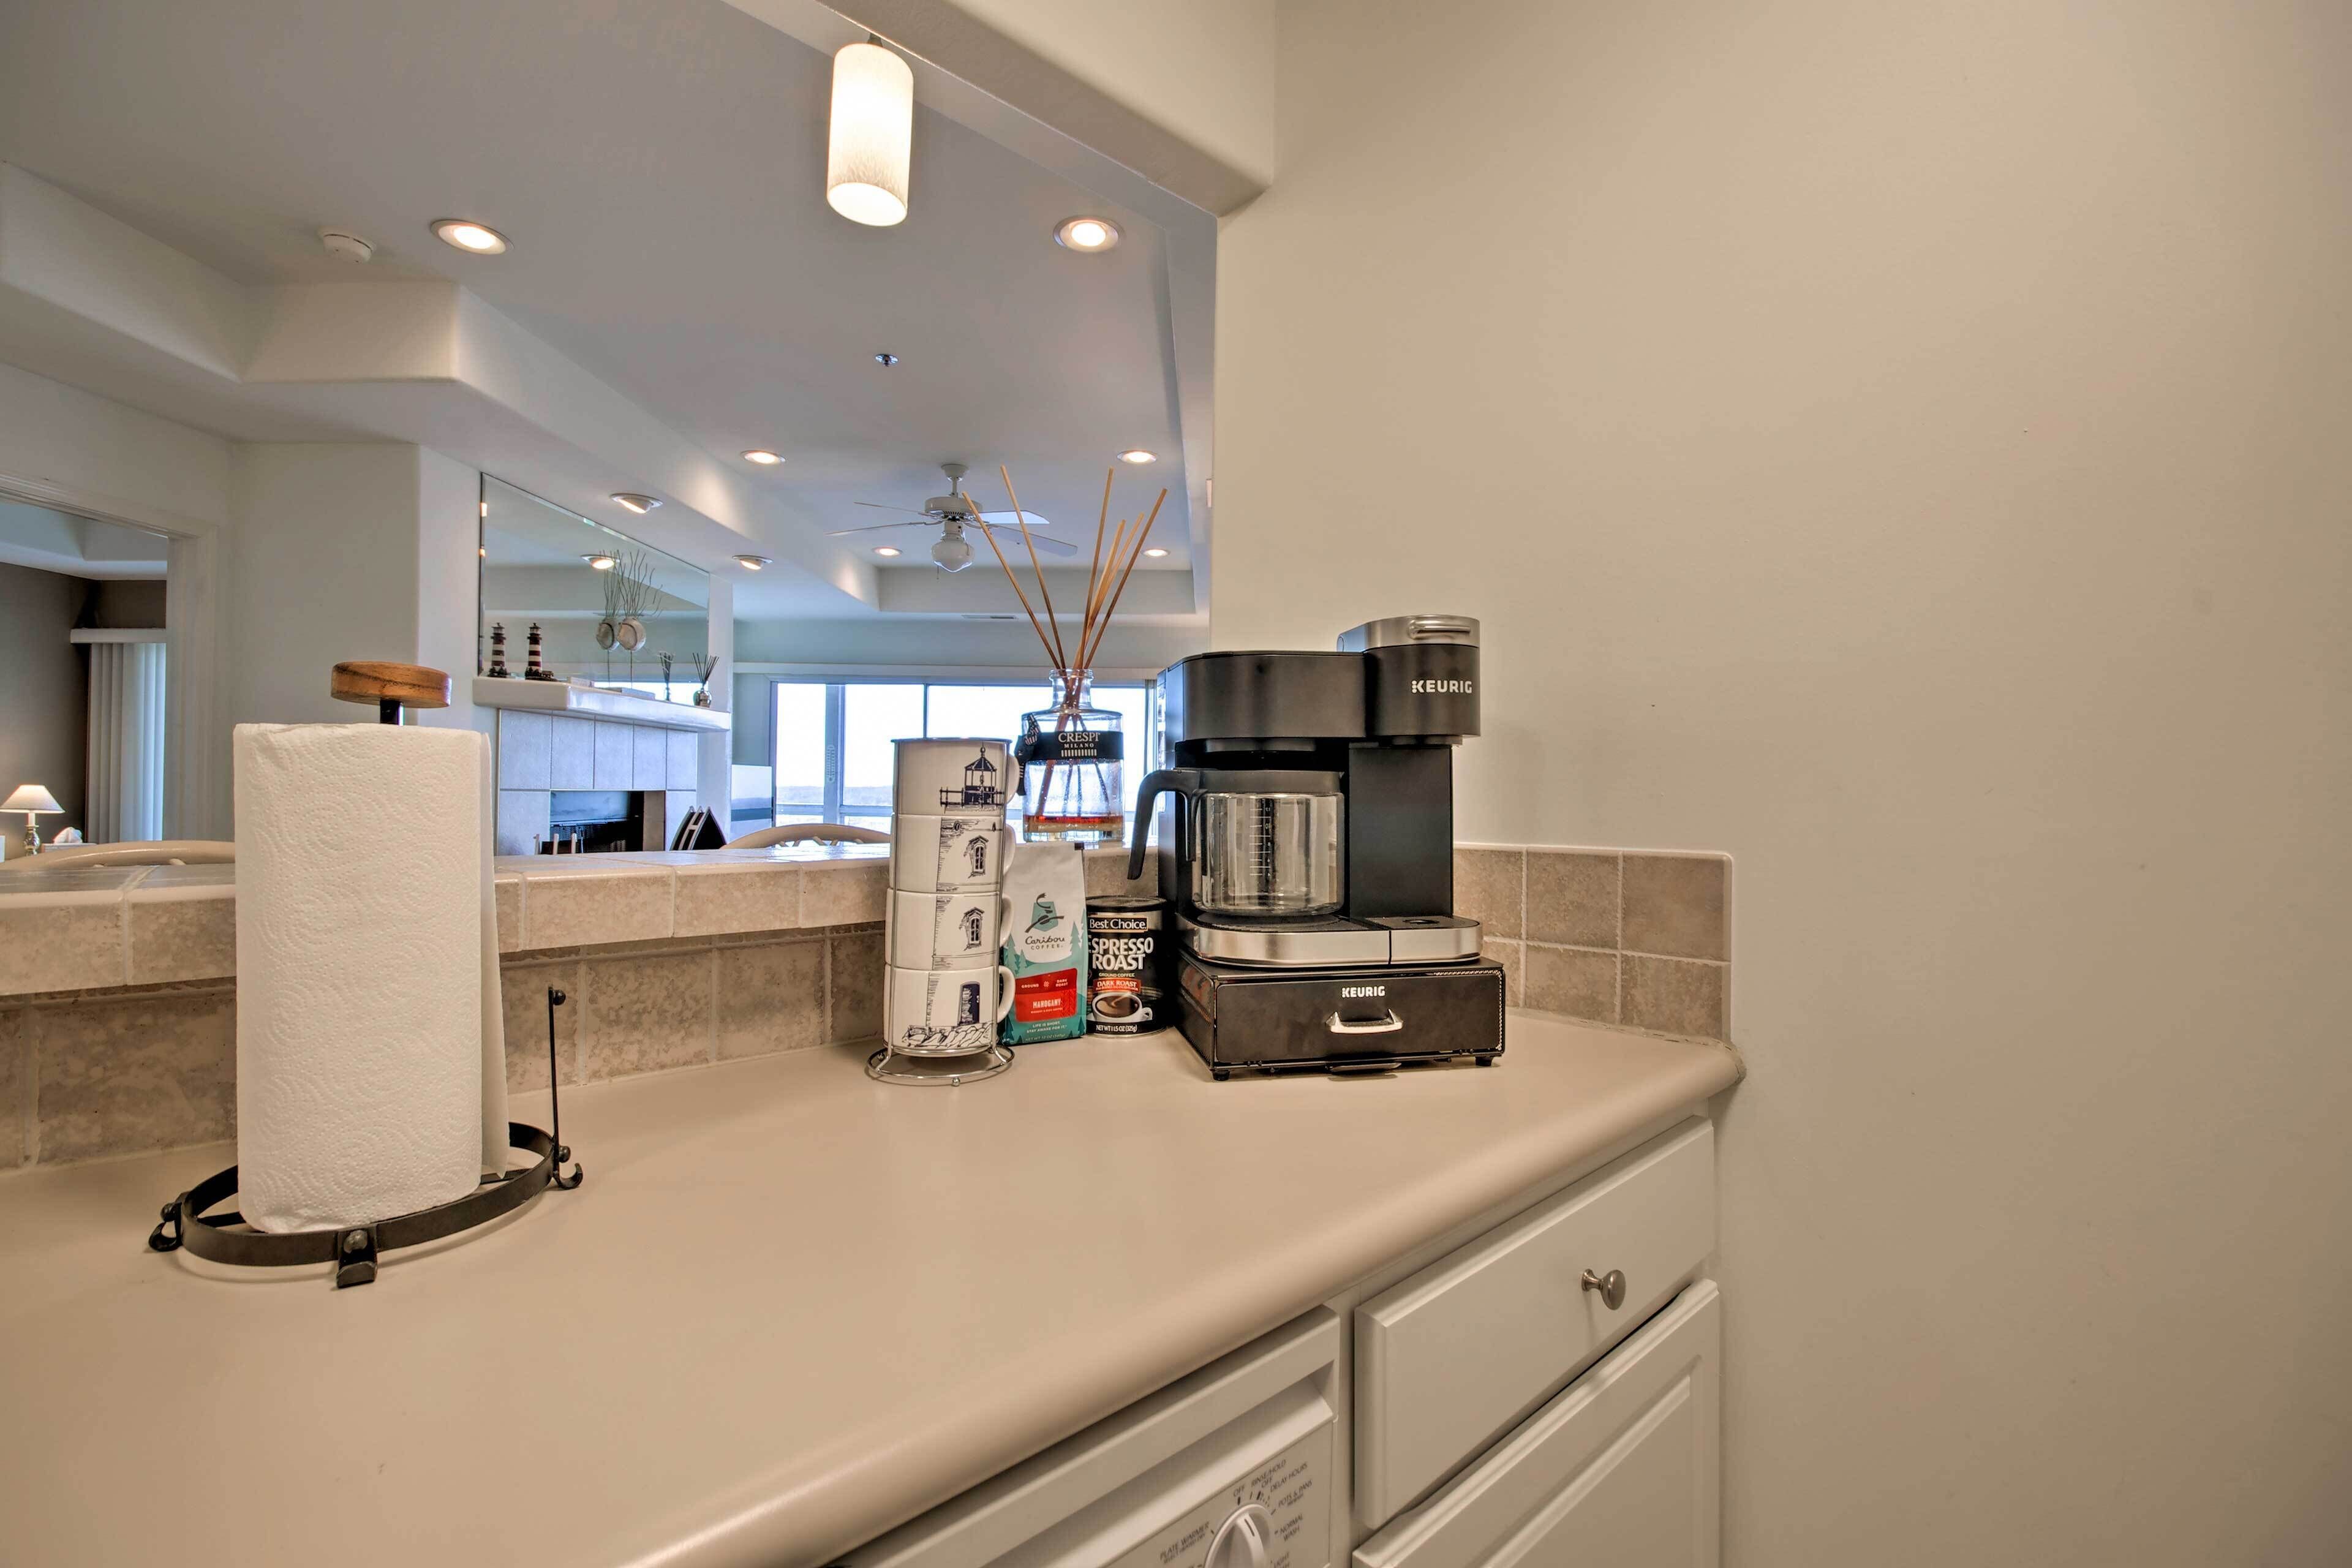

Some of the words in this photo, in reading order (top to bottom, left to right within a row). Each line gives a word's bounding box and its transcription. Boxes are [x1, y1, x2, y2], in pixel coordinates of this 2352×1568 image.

[1411, 680, 1472, 693] KEURIG
[1058, 732, 1099, 742] CRESPI
[1090, 919, 1109, 929] Best
[1025, 935, 1065, 945] Caribou
[1092, 954, 1146, 971] ROAST
[1341, 986, 1385, 998] KEURIG
[1033, 998, 1061, 1009] MAHOGANY
[1251, 1460, 1286, 1487] RINSE/HOLD
[1270, 1477, 1287, 1493] DELAY
[1289, 1462, 1308, 1479] HOURS
[1261, 1477, 1273, 1488] OFF
[1233, 1485, 1245, 1497] OFF
[1278, 1493, 1292, 1507] POTS
[1298, 1479, 1313, 1493] PANS
[1280, 1513, 1303, 1534] NORMAL
[1283, 1525, 1300, 1542] WASH
[1160, 1542, 1178, 1561] PLATE
[1181, 1521, 1210, 1545] WARMER
